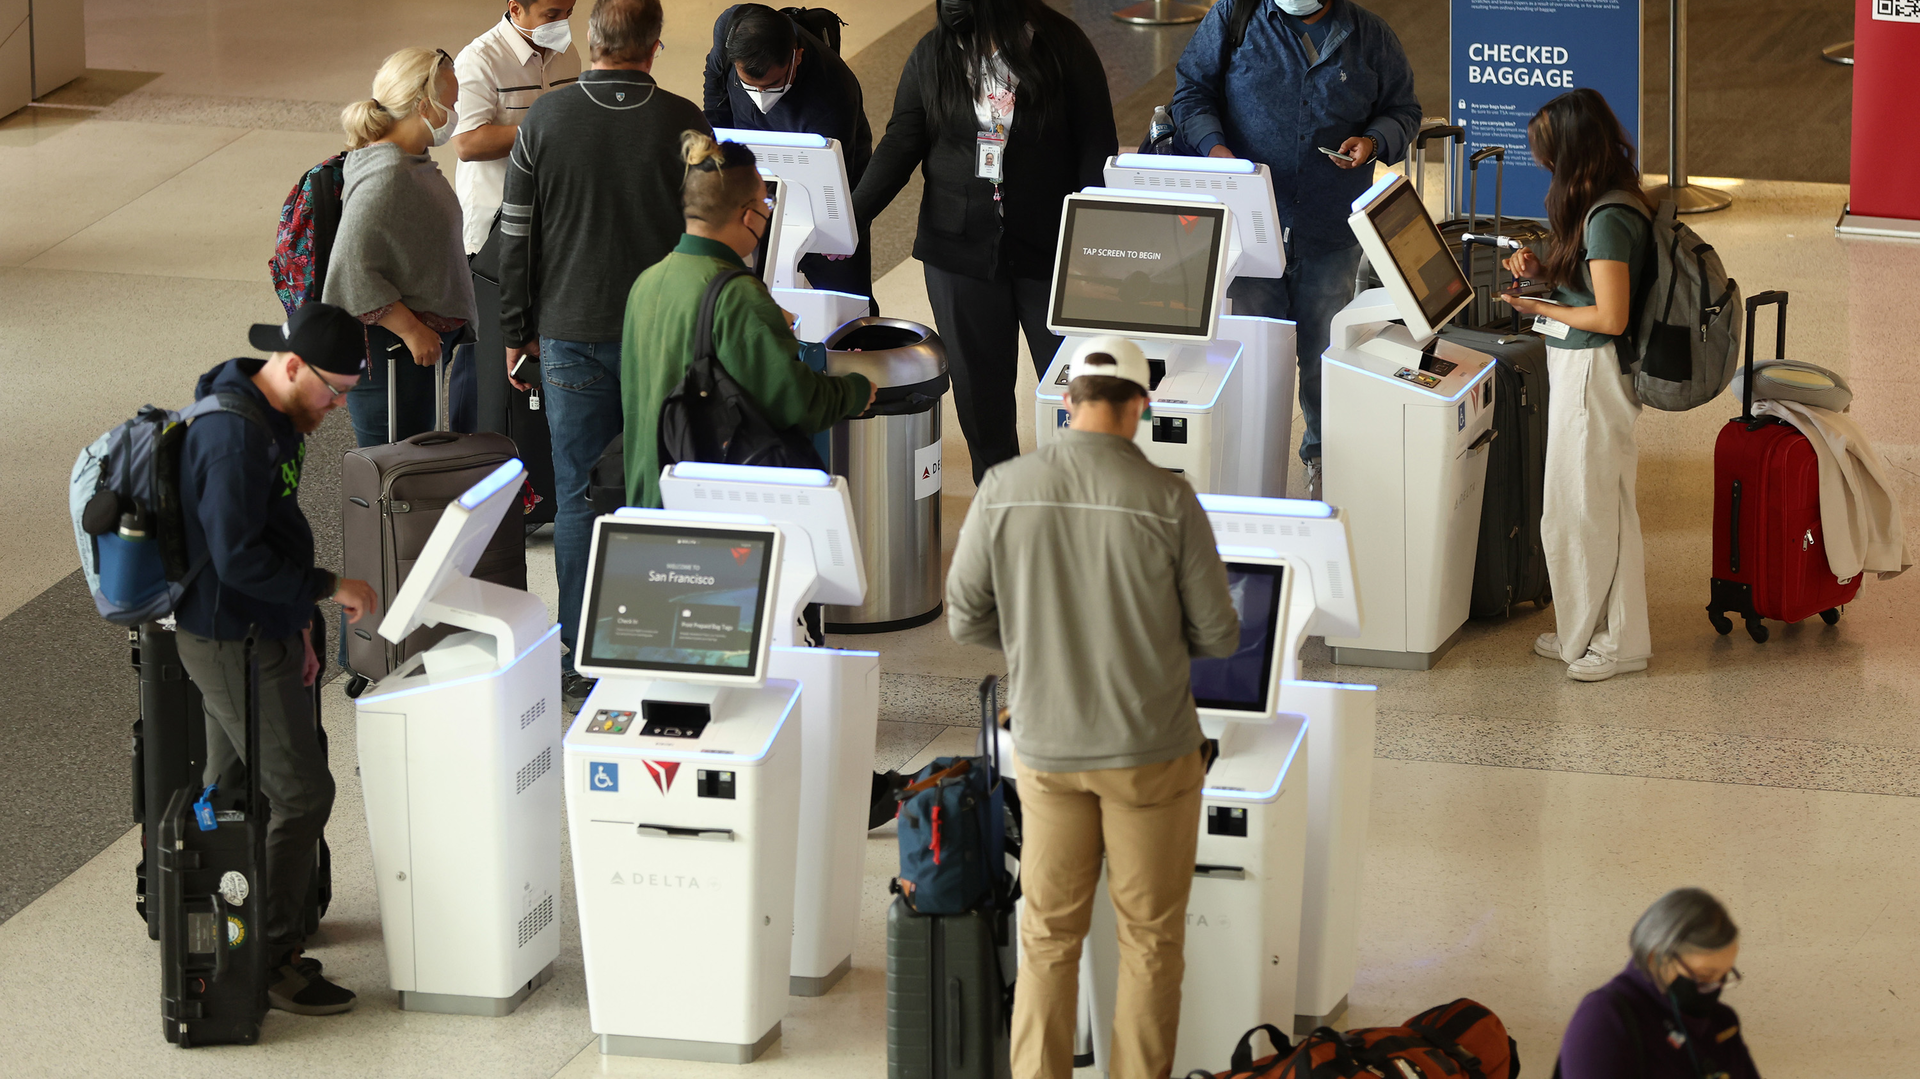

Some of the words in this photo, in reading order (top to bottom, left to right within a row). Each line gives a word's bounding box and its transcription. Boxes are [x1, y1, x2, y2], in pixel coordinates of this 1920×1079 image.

[1468, 43, 1568, 64] CHECKED
[1468, 66, 1574, 88] BAGGAGE
[1098, 249, 1125, 258] SCREEN
[1139, 252, 1161, 260] BEGIN
[648, 571, 666, 582] San
[668, 572, 715, 586] Francisco
[632, 872, 700, 889] DELTA
